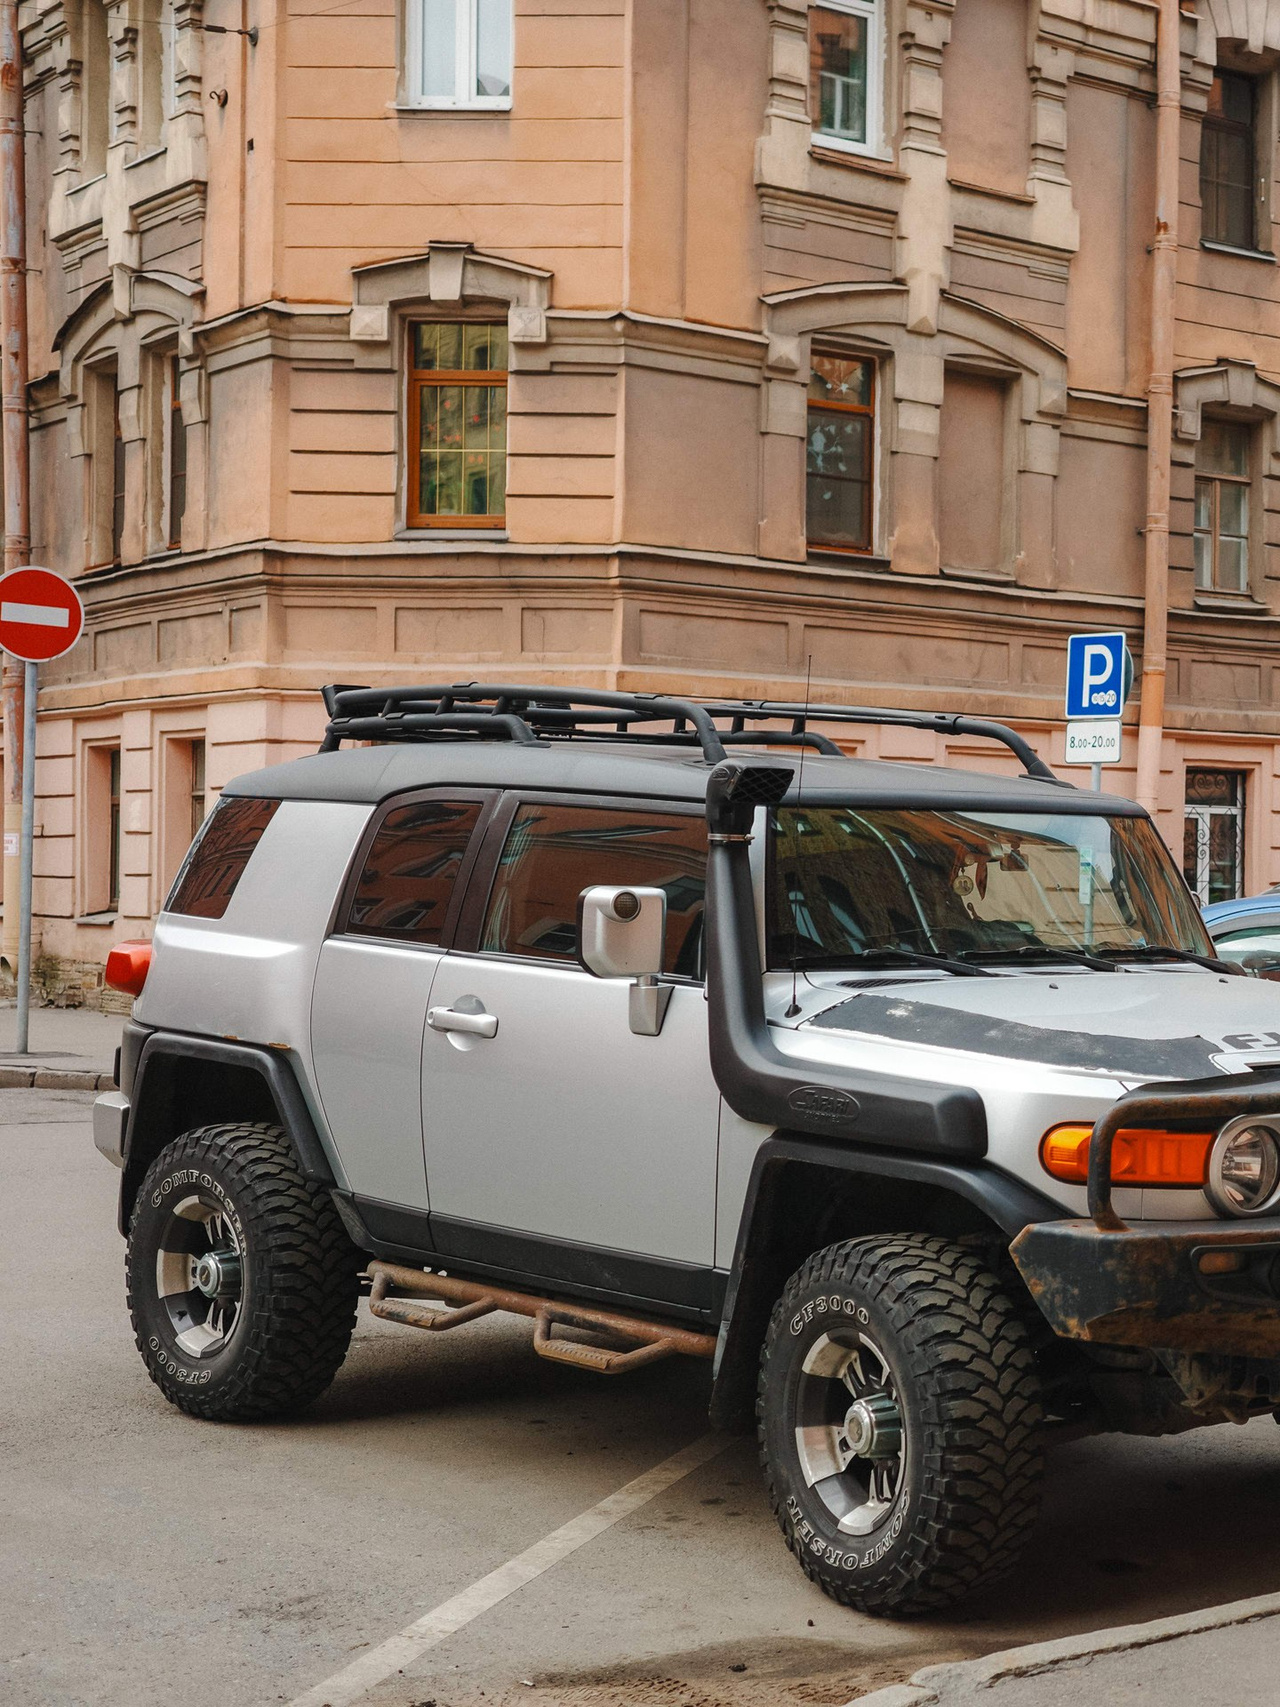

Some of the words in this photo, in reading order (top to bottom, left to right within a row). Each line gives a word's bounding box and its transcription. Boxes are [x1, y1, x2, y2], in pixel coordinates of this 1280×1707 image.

[1081, 644, 1113, 708] P
[1069, 735, 1116, 749] 8.00-20.00
[789, 1294, 870, 1337] CF3000
[148, 1336, 212, 1385] CF3000
[785, 1487, 911, 1571] COMFORSER
